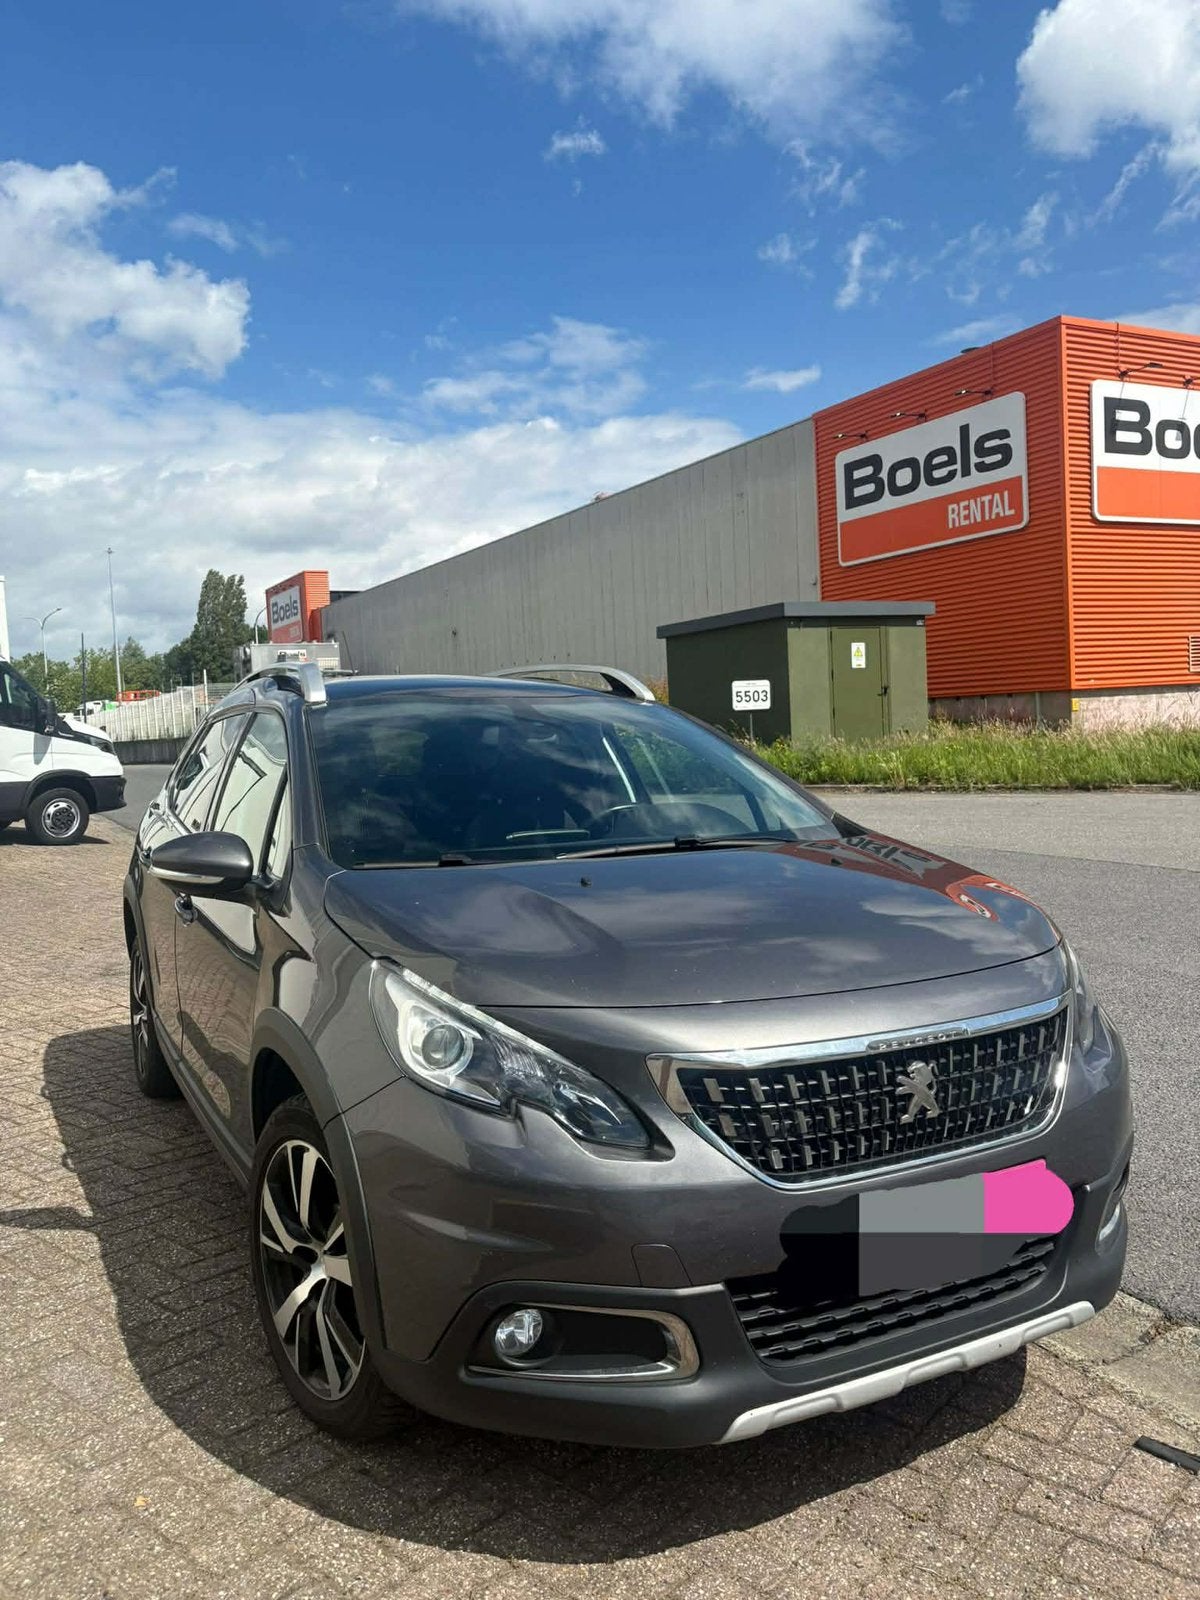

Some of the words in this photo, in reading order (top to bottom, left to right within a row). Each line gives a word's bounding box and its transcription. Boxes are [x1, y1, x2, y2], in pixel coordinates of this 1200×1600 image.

[1103, 396, 1200, 460] Bo
[844, 423, 1014, 511] Boels
[948, 490, 1015, 529] RENTAL
[271, 594, 299, 624] Boels
[735, 690, 768, 703] 5503
